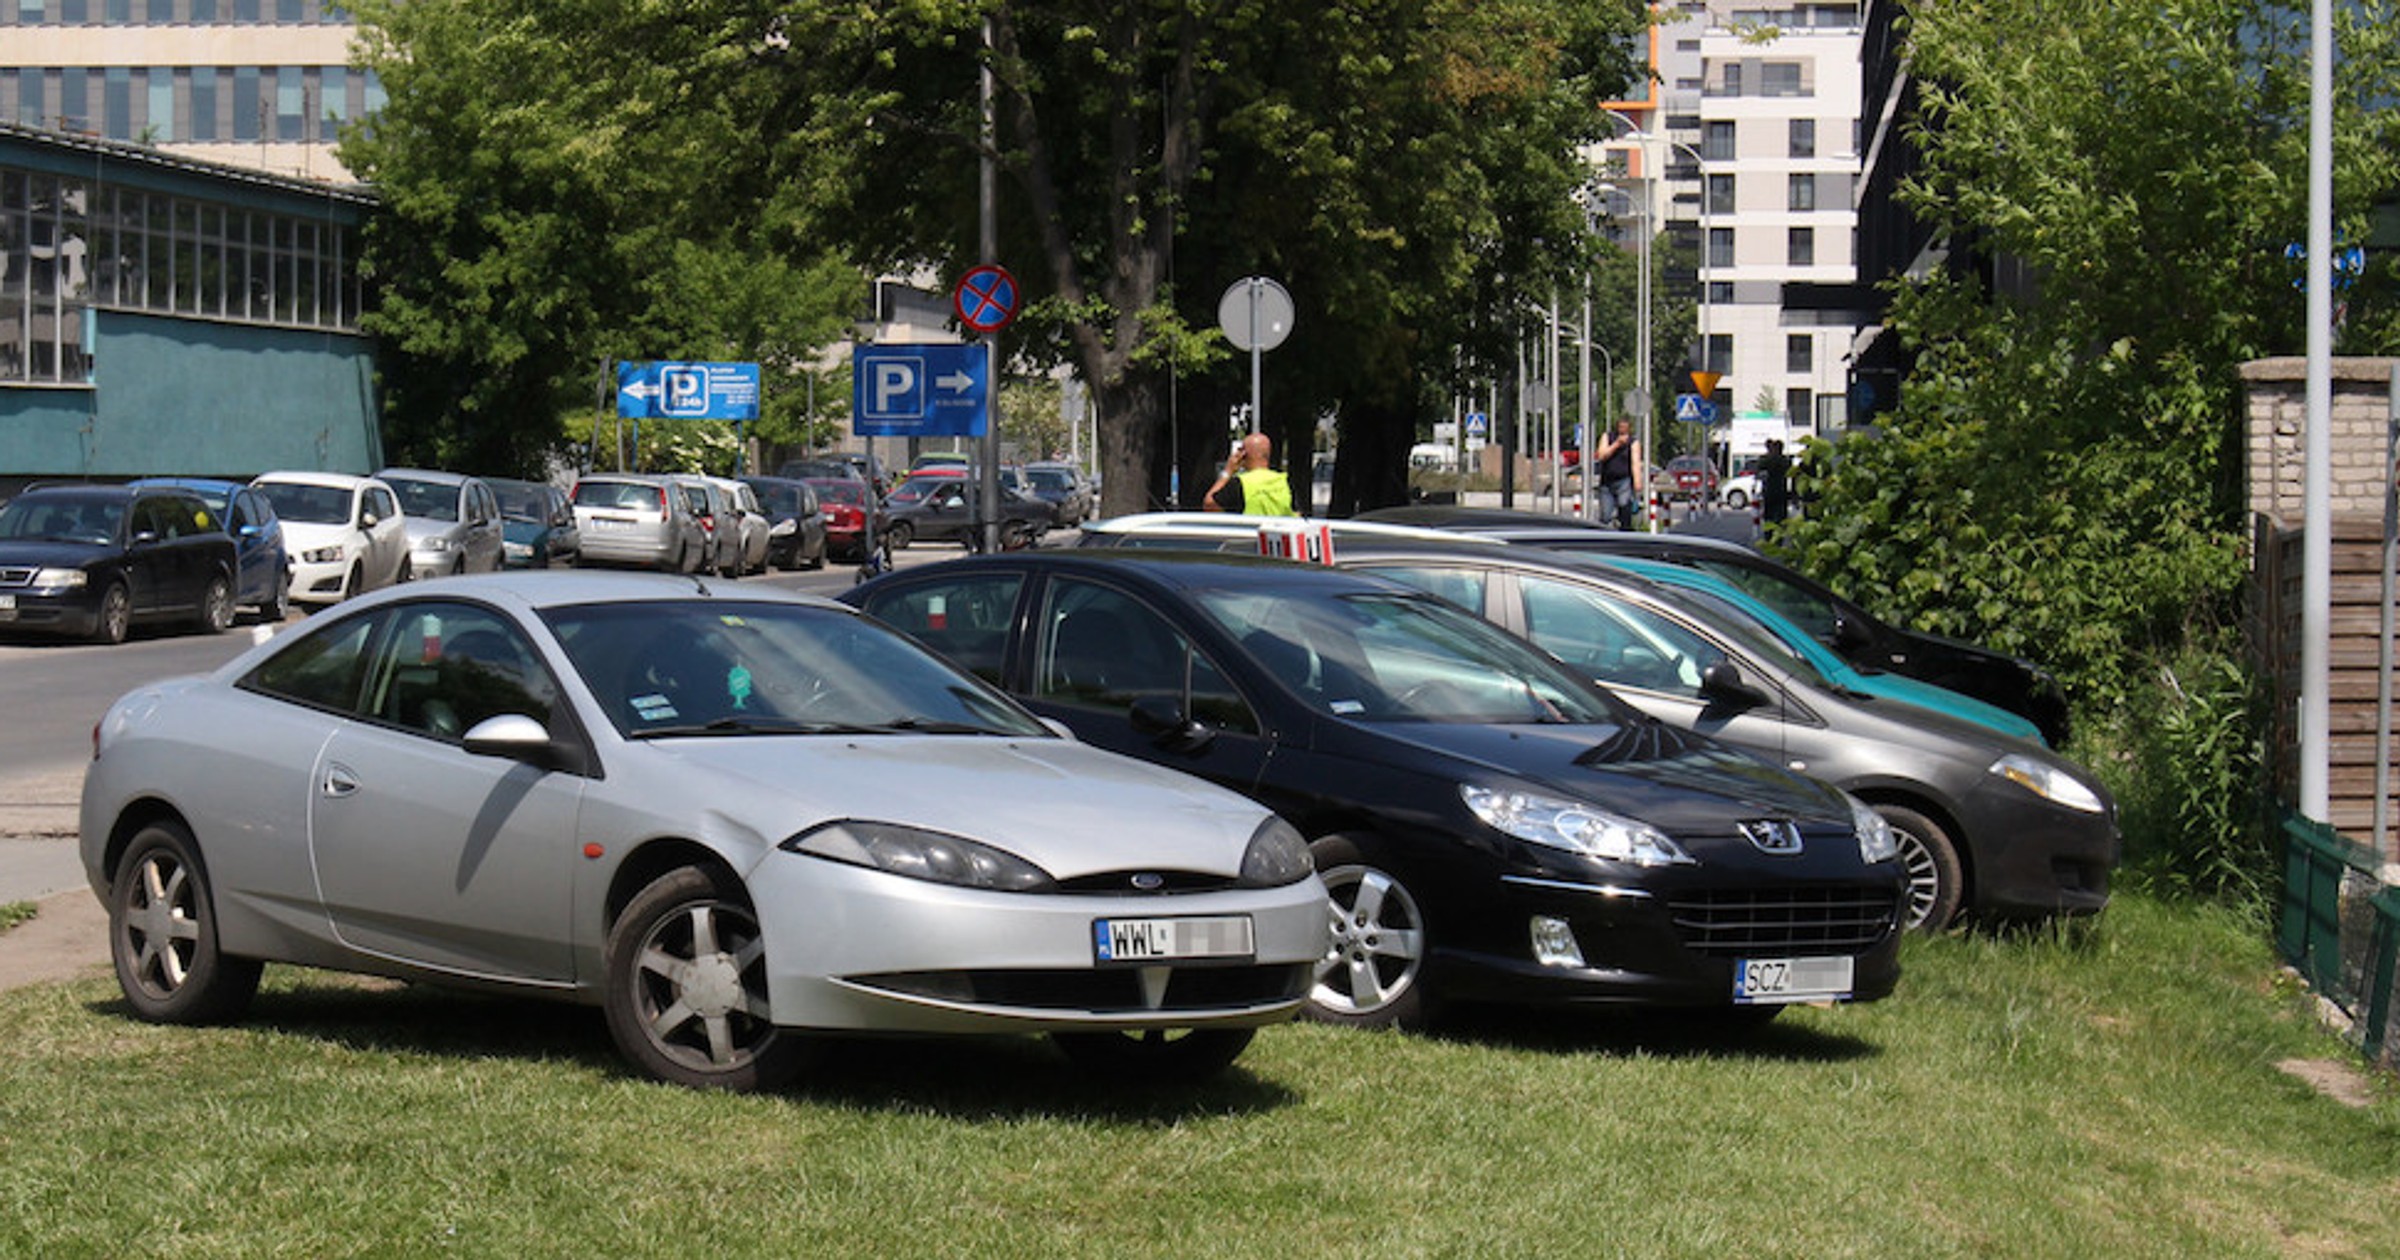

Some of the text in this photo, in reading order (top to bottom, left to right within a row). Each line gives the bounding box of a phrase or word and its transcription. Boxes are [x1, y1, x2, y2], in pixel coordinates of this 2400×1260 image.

[670, 373, 698, 407] P
[876, 363, 914, 412] P
[1112, 922, 1164, 956] WWL
[1746, 962, 1786, 992] SCZ
